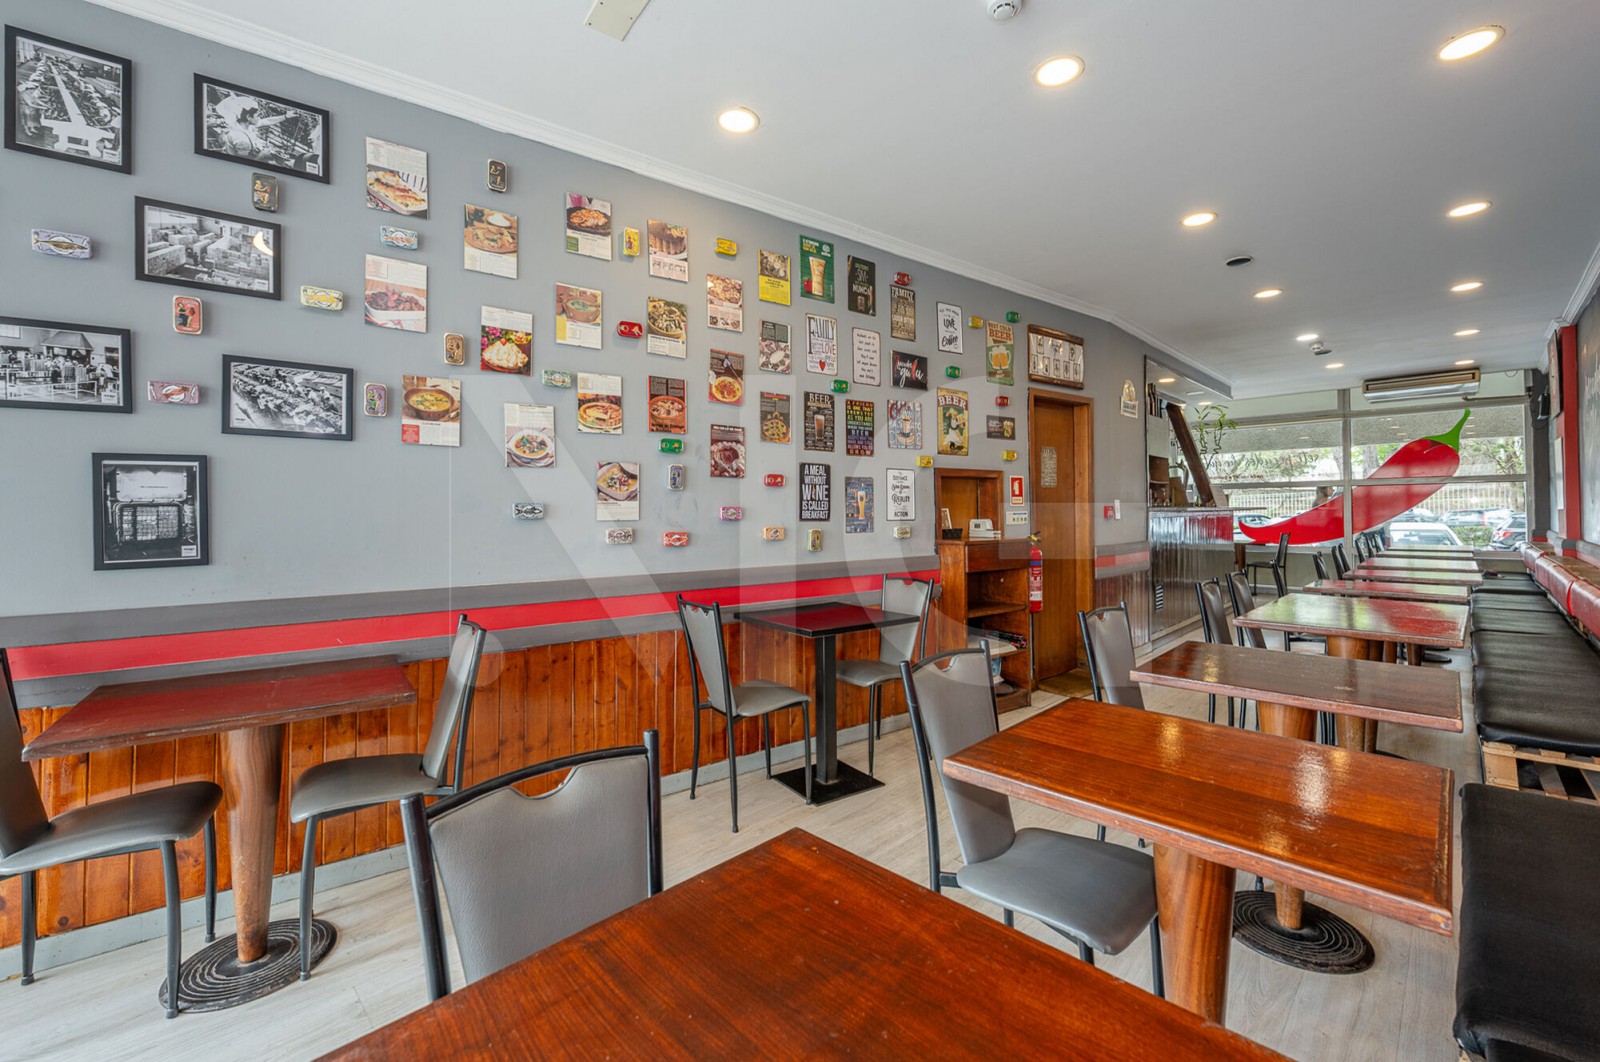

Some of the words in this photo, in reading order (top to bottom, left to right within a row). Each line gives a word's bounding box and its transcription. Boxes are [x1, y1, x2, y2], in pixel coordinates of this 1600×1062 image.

[989, 328, 1012, 341] BEER
[942, 335, 958, 347] Coffee
[810, 393, 830, 404] BEER
[938, 395, 967, 410] BEER
[805, 464, 809, 475] A
[810, 464, 826, 476] MEAL
[804, 476, 826, 485] WITHOUT
[802, 484, 829, 501] WINE
[802, 501, 808, 510] IS
[808, 501, 829, 511] CALLED
[802, 511, 829, 519] BREAKFAST
